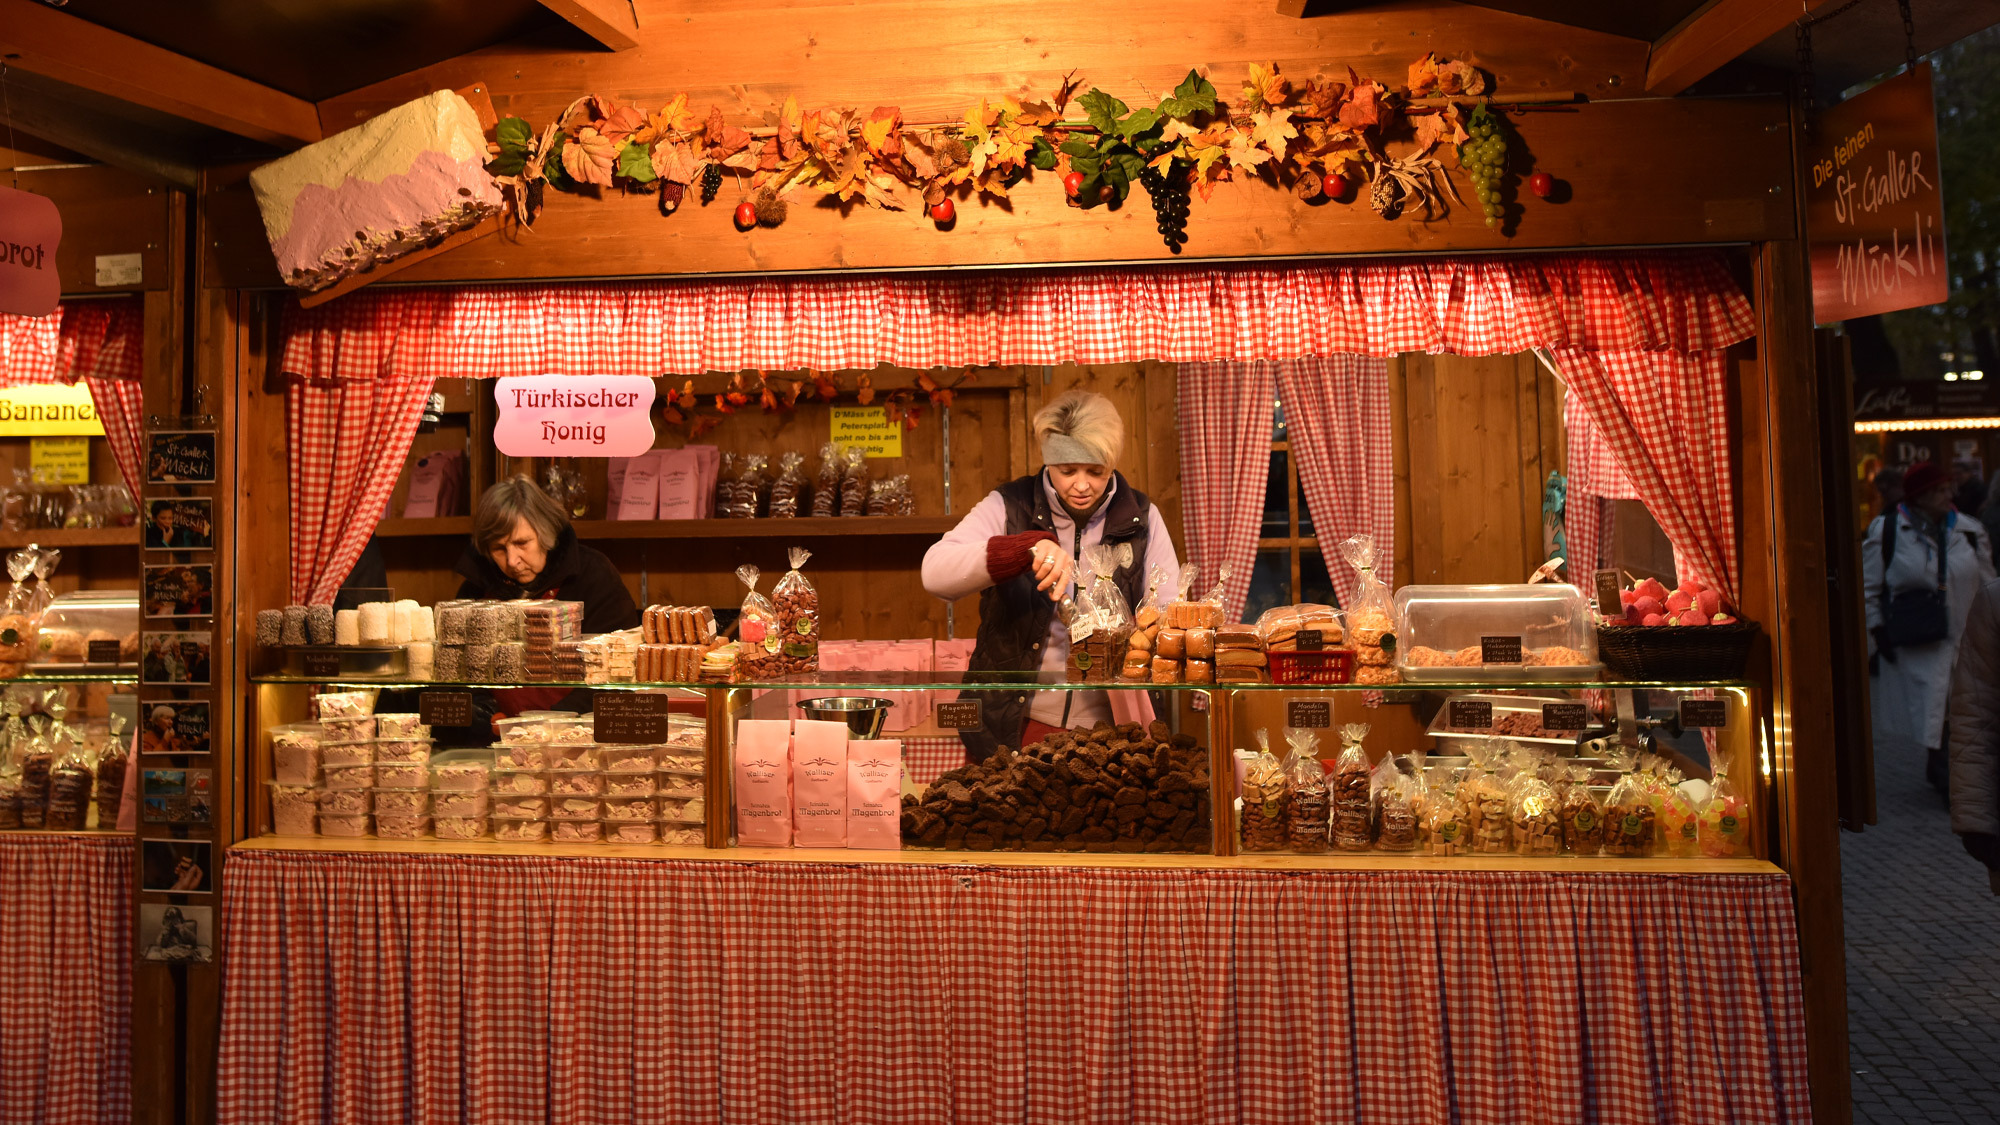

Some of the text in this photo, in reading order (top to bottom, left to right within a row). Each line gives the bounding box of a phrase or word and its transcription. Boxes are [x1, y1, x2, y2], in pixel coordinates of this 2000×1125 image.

[1813, 122, 1875, 188] Die feinen
[511, 388, 639, 408] Türkischer
[541, 421, 606, 445] Honig
[940, 704, 977, 713] Magenbrot
[741, 809, 782, 817] Magenbrot
[799, 808, 841, 816] Magenbrot
[852, 809, 895, 817] Magenbrot
